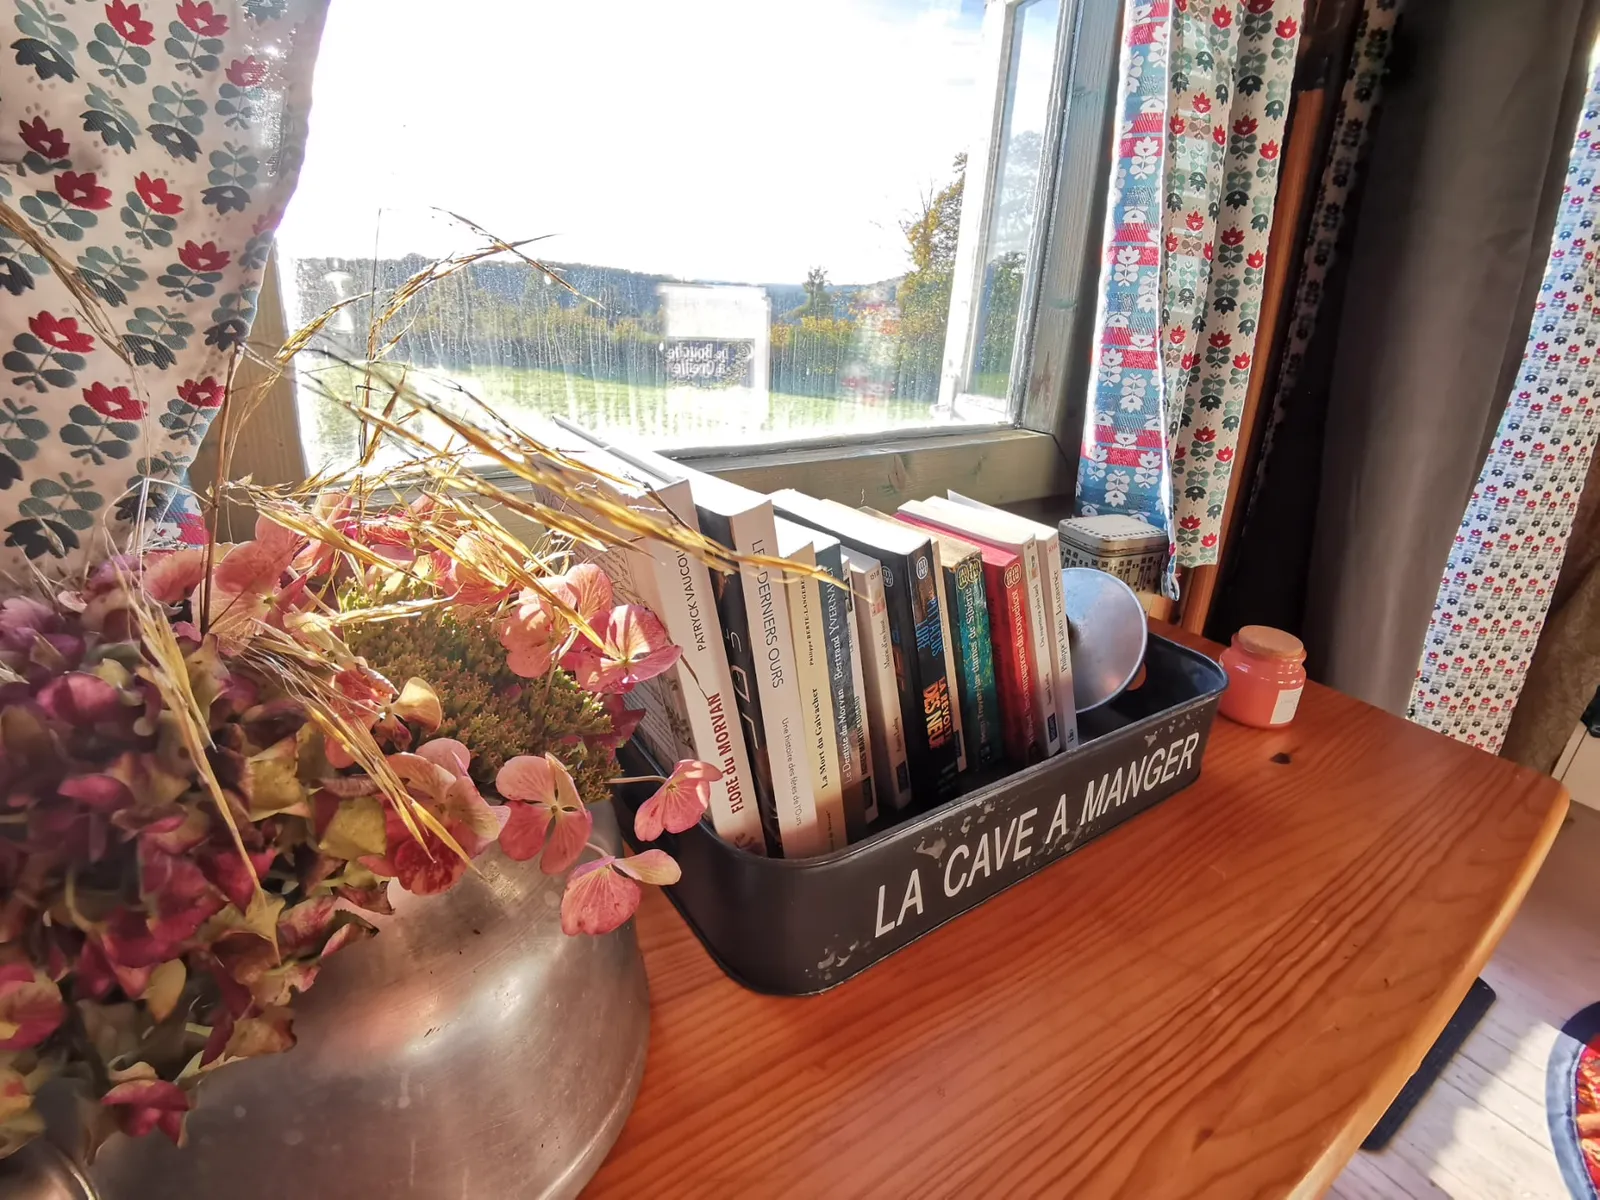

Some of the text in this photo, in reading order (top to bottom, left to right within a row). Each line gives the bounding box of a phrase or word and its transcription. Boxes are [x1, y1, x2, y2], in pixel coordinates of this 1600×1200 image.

[675, 548, 706, 652] PATRYCK VAUCOU
[752, 539, 784, 688] LE DERNIERS OURS
[965, 588, 975, 625] Sibérie
[1012, 589, 1024, 633] coquelicot
[915, 619, 931, 652] LORE
[927, 596, 943, 656] PITTACUS
[968, 626, 977, 640] de
[1016, 633, 1025, 647] du
[830, 635, 843, 681] Bertrand
[971, 640, 981, 674] dames
[1060, 643, 1068, 673] Philippe
[923, 684, 941, 714] DES
[938, 675, 947, 692] LA
[708, 692, 744, 814] FLORE du MORVAN
[785, 734, 793, 762] histoire
[812, 688, 829, 789] La Mort du Galvacher
[837, 688, 853, 783] Le Dentiste du Morvan
[788, 762, 796, 776] des
[790, 776, 798, 795] fêtes
[875, 731, 1200, 939] LA CAVE A MANGER
